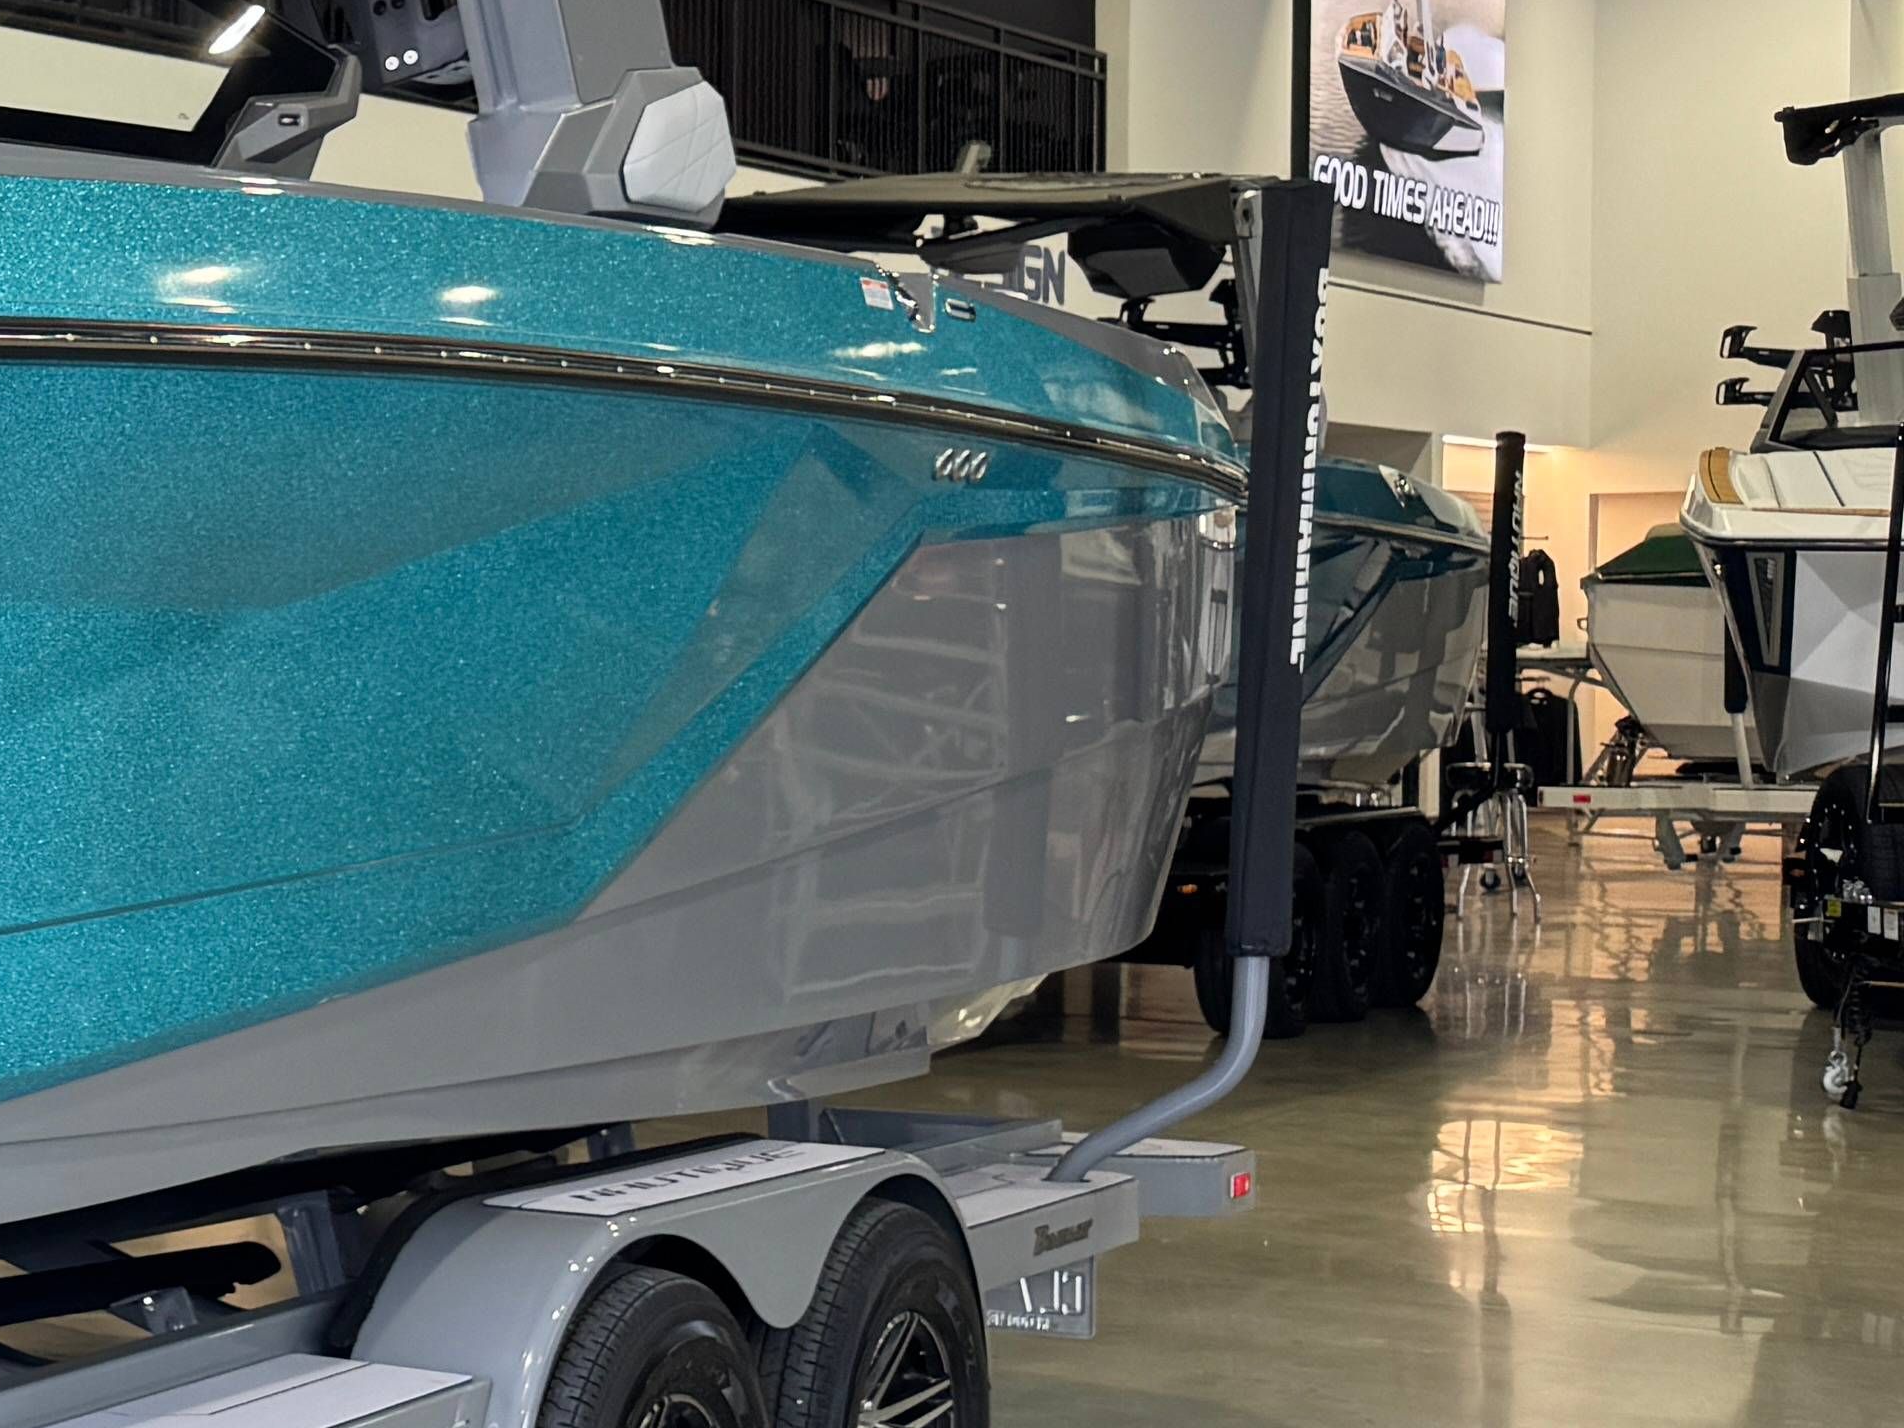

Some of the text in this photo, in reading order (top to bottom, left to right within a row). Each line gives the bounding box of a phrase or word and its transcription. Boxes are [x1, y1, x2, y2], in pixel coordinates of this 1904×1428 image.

[1313, 155, 1500, 245] GOOD TIMES AHEAD!!!
